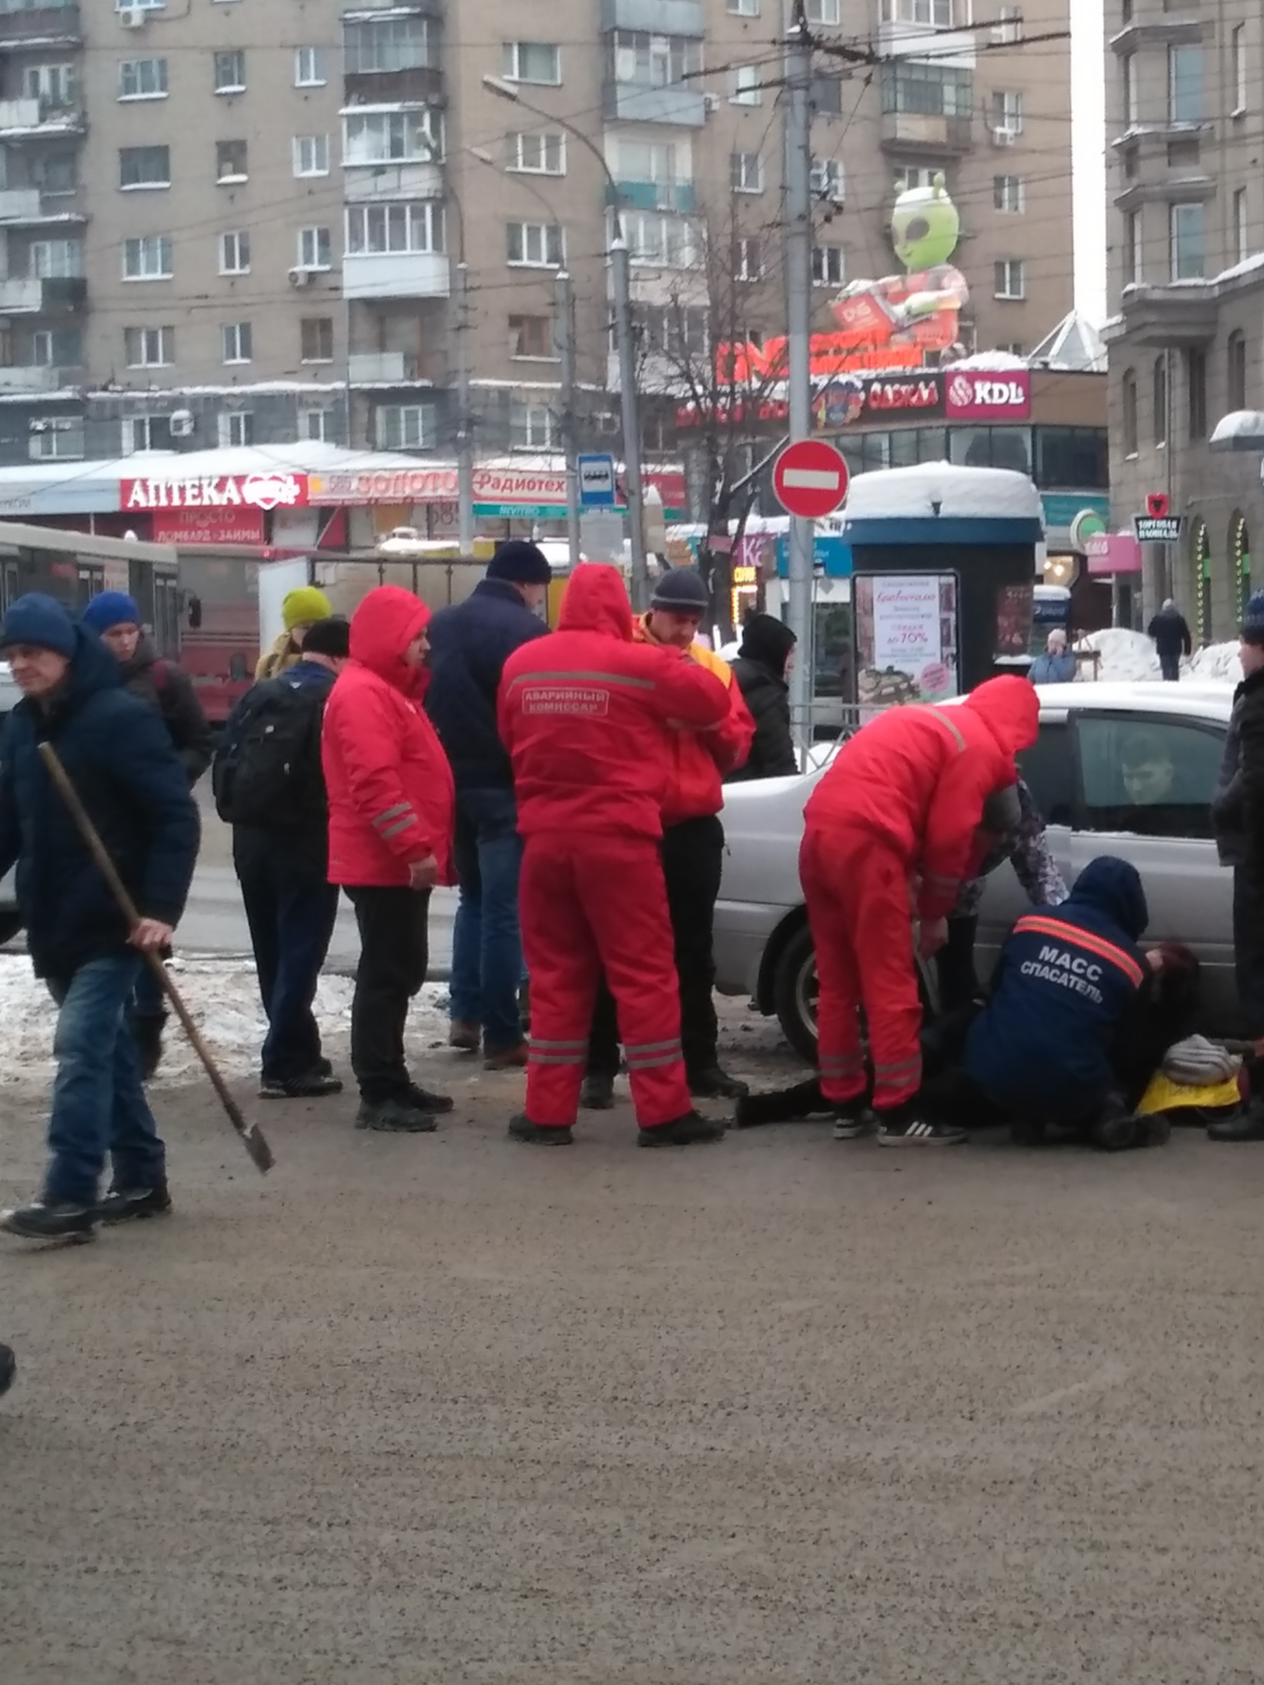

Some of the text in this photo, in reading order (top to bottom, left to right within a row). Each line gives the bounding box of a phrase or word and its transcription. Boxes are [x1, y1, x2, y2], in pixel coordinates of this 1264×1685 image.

[974, 382, 1025, 405] KDL
[127, 477, 242, 507] АПТЕКА
[358, 471, 457, 493] ЗОЛОТО
[478, 471, 565, 493] Радиотех
[528, 702, 598, 714] КОМИССАР
[1038, 945, 1103, 982] МАСС
[1020, 960, 1103, 1004] СПАСАТЕЛЬ
